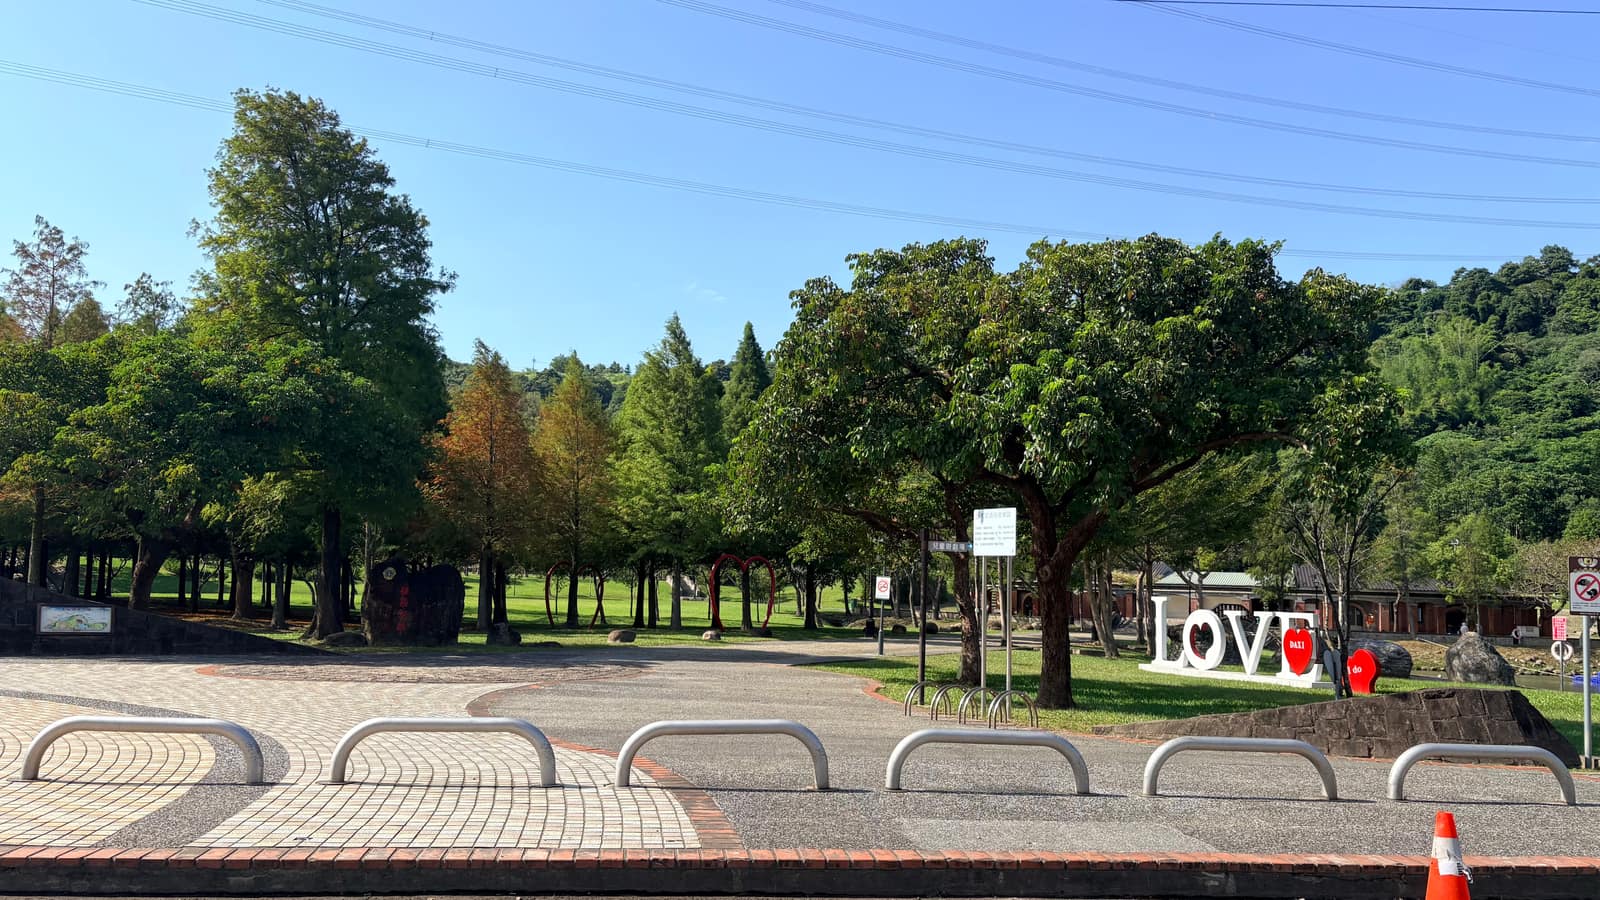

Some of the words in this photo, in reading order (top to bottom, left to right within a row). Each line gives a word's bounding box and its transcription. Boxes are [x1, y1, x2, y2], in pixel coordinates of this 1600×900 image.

[1151, 596, 1322, 682] LOVE
[1289, 640, 1305, 650] DAXI
[1352, 664, 1362, 673] do
